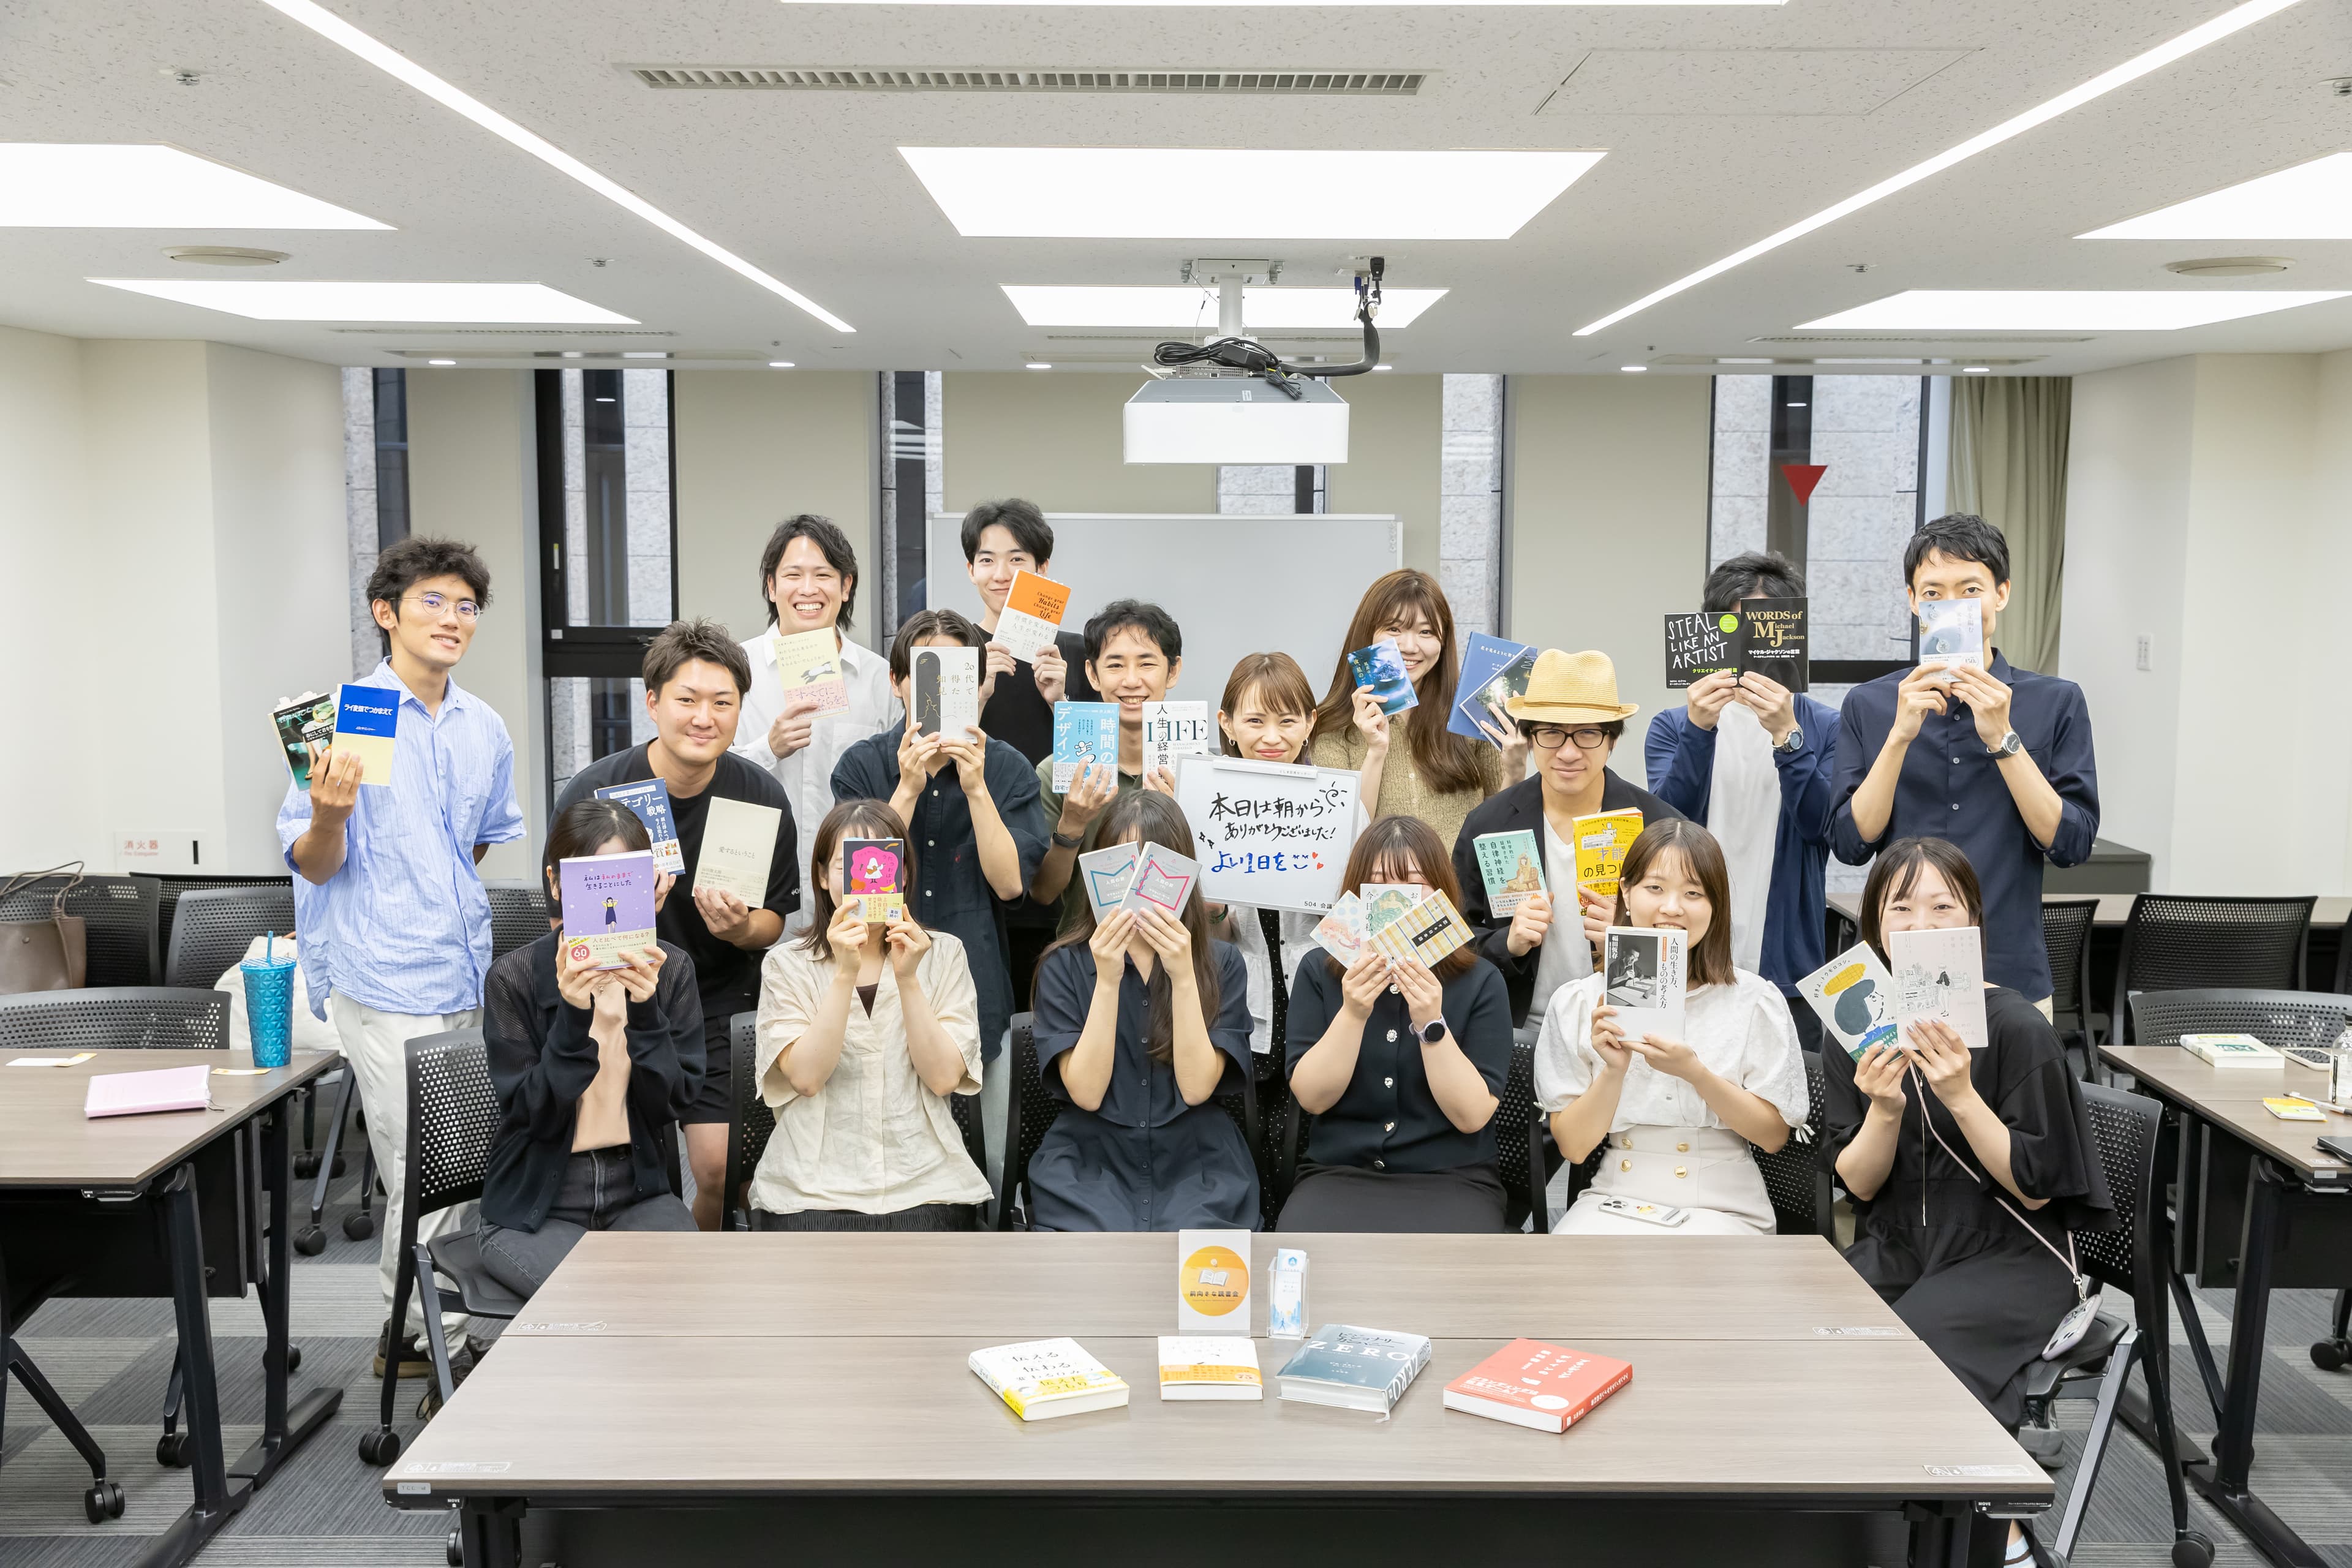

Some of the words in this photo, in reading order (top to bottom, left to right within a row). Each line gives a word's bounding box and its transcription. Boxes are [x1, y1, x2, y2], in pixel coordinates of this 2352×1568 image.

[1038, 598, 1060, 610] Habits
[1039, 610, 1052, 619] Life
[1746, 611, 1790, 620] WORDS
[1792, 611, 1803, 620] of
[1667, 613, 1718, 640] STEAL
[1753, 621, 1795, 638] Michael
[1671, 636, 1698, 652] LIKE
[1703, 631, 1719, 644] AN
[1770, 629, 1805, 647] Jackson
[1672, 642, 1728, 669] ARTIST
[1055, 706, 1072, 764] デザイン
[1099, 717, 1117, 764] 時間の
[1147, 720, 1208, 742] LIFE
[1156, 704, 1169, 777] 人生の経営
[620, 793, 664, 808] テゴリー
[646, 804, 667, 817] 戦略
[1208, 792, 1324, 821] 本日は朝から
[124, 839, 159, 850] 消火器
[718, 846, 756, 859] 愛するということ
[1499, 840, 1510, 865] 証明された
[1506, 839, 1515, 859] 科学的に
[1596, 847, 1626, 862] 才能
[1210, 850, 1288, 874] よい1日を
[1479, 842, 1496, 886] 整える習慣
[1490, 841, 1507, 884] 自律神経を
[1583, 864, 1621, 878] の見つ
[585, 880, 632, 891] 生きることにした
[1365, 891, 1374, 932] 今日の私
[1670, 937, 1679, 988] 人間の生き方、
[1659, 962, 1668, 1009] ものの考え方
[1814, 959, 1851, 999] 好きよ、トウモロコシ。
[1307, 1341, 1411, 1361] ZERO
